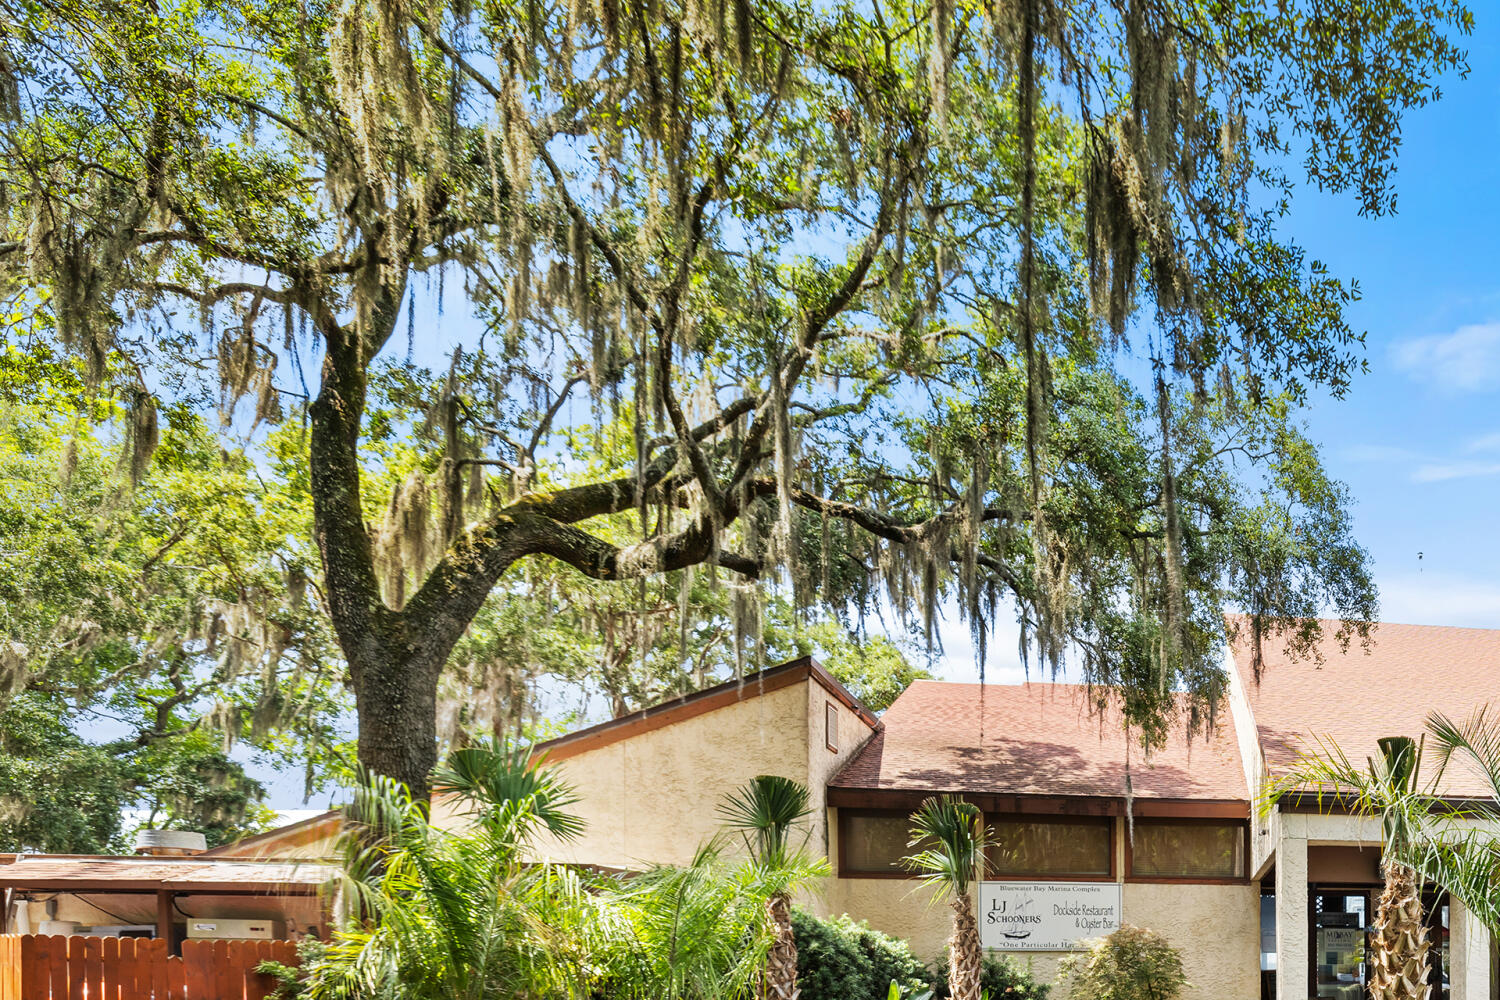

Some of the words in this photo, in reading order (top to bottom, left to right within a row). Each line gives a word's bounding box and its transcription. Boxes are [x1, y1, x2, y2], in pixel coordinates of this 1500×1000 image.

[1033, 885, 1045, 893] Bay
[991, 898, 1007, 914] LJ
[1053, 900, 1081, 916] Dockside
[1082, 904, 1114, 916] Restaurant
[1075, 917, 1080, 928] &
[1081, 917, 1102, 935] Oyster
[1102, 917, 1114, 929] Bar
